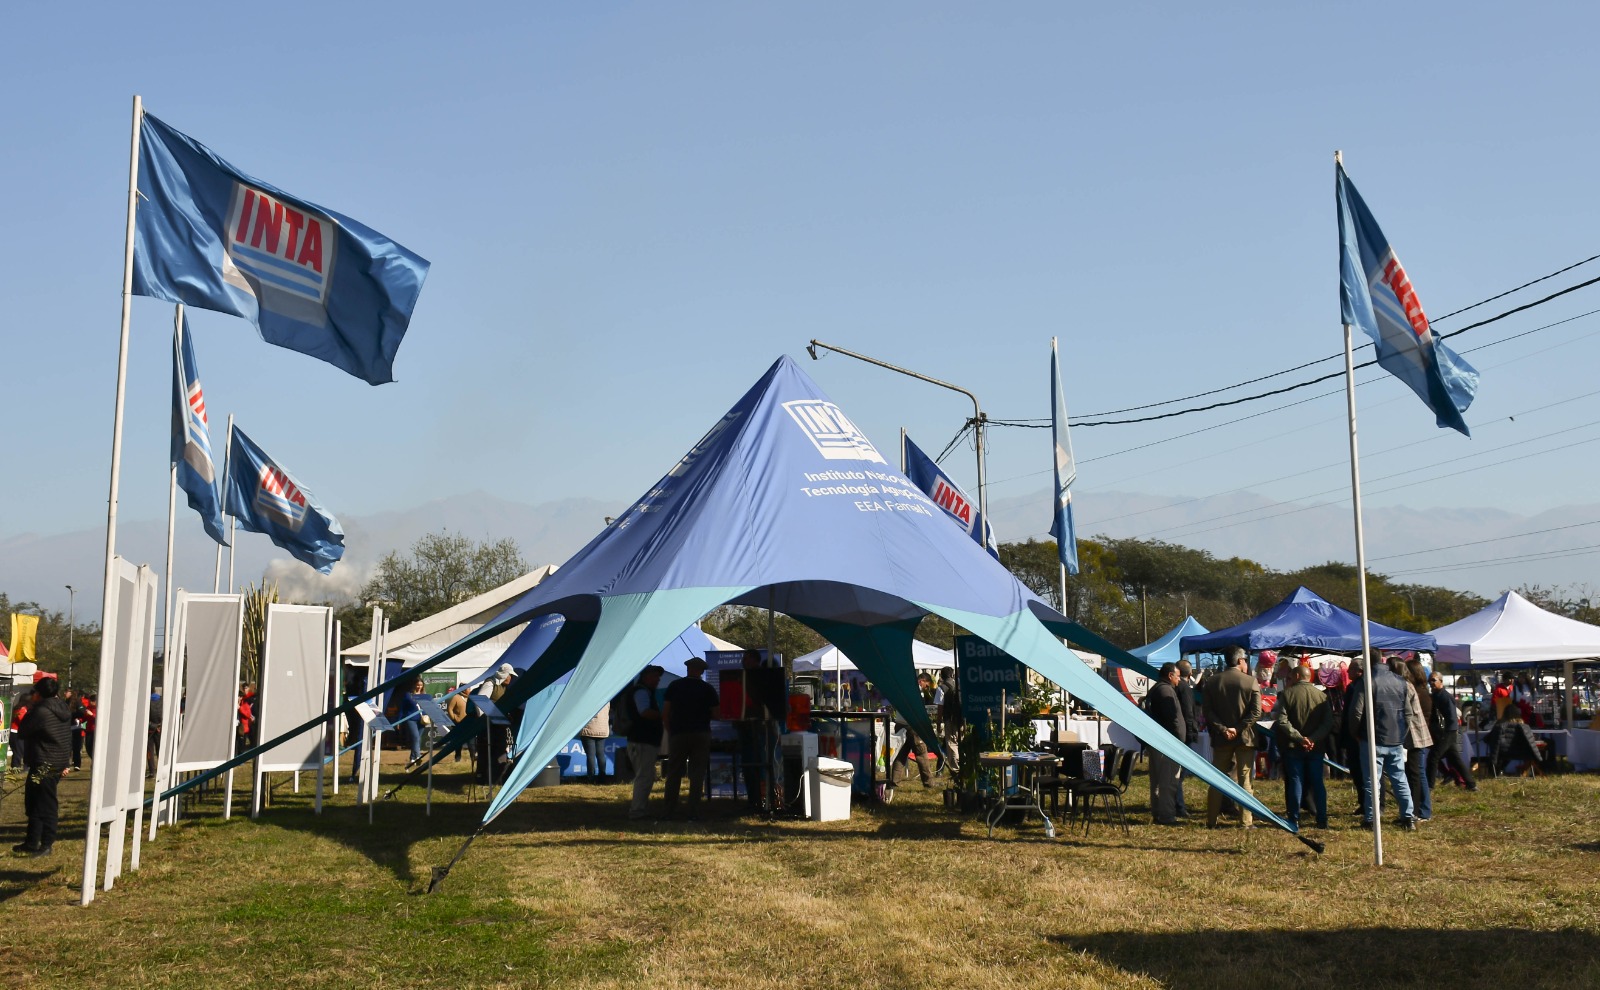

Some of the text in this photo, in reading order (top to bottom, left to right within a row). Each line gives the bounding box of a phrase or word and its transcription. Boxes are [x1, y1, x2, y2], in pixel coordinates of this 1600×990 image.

[235, 188, 323, 274] INTA
[1381, 257, 1430, 337] INTA
[793, 404, 863, 438] INTA
[261, 465, 306, 508] INTA
[800, 483, 880, 498] Tecnología
[804, 469, 865, 483] Instituto
[853, 501, 886, 512] EEA
[932, 481, 971, 524] INTA
[966, 664, 1019, 683] Clonal
